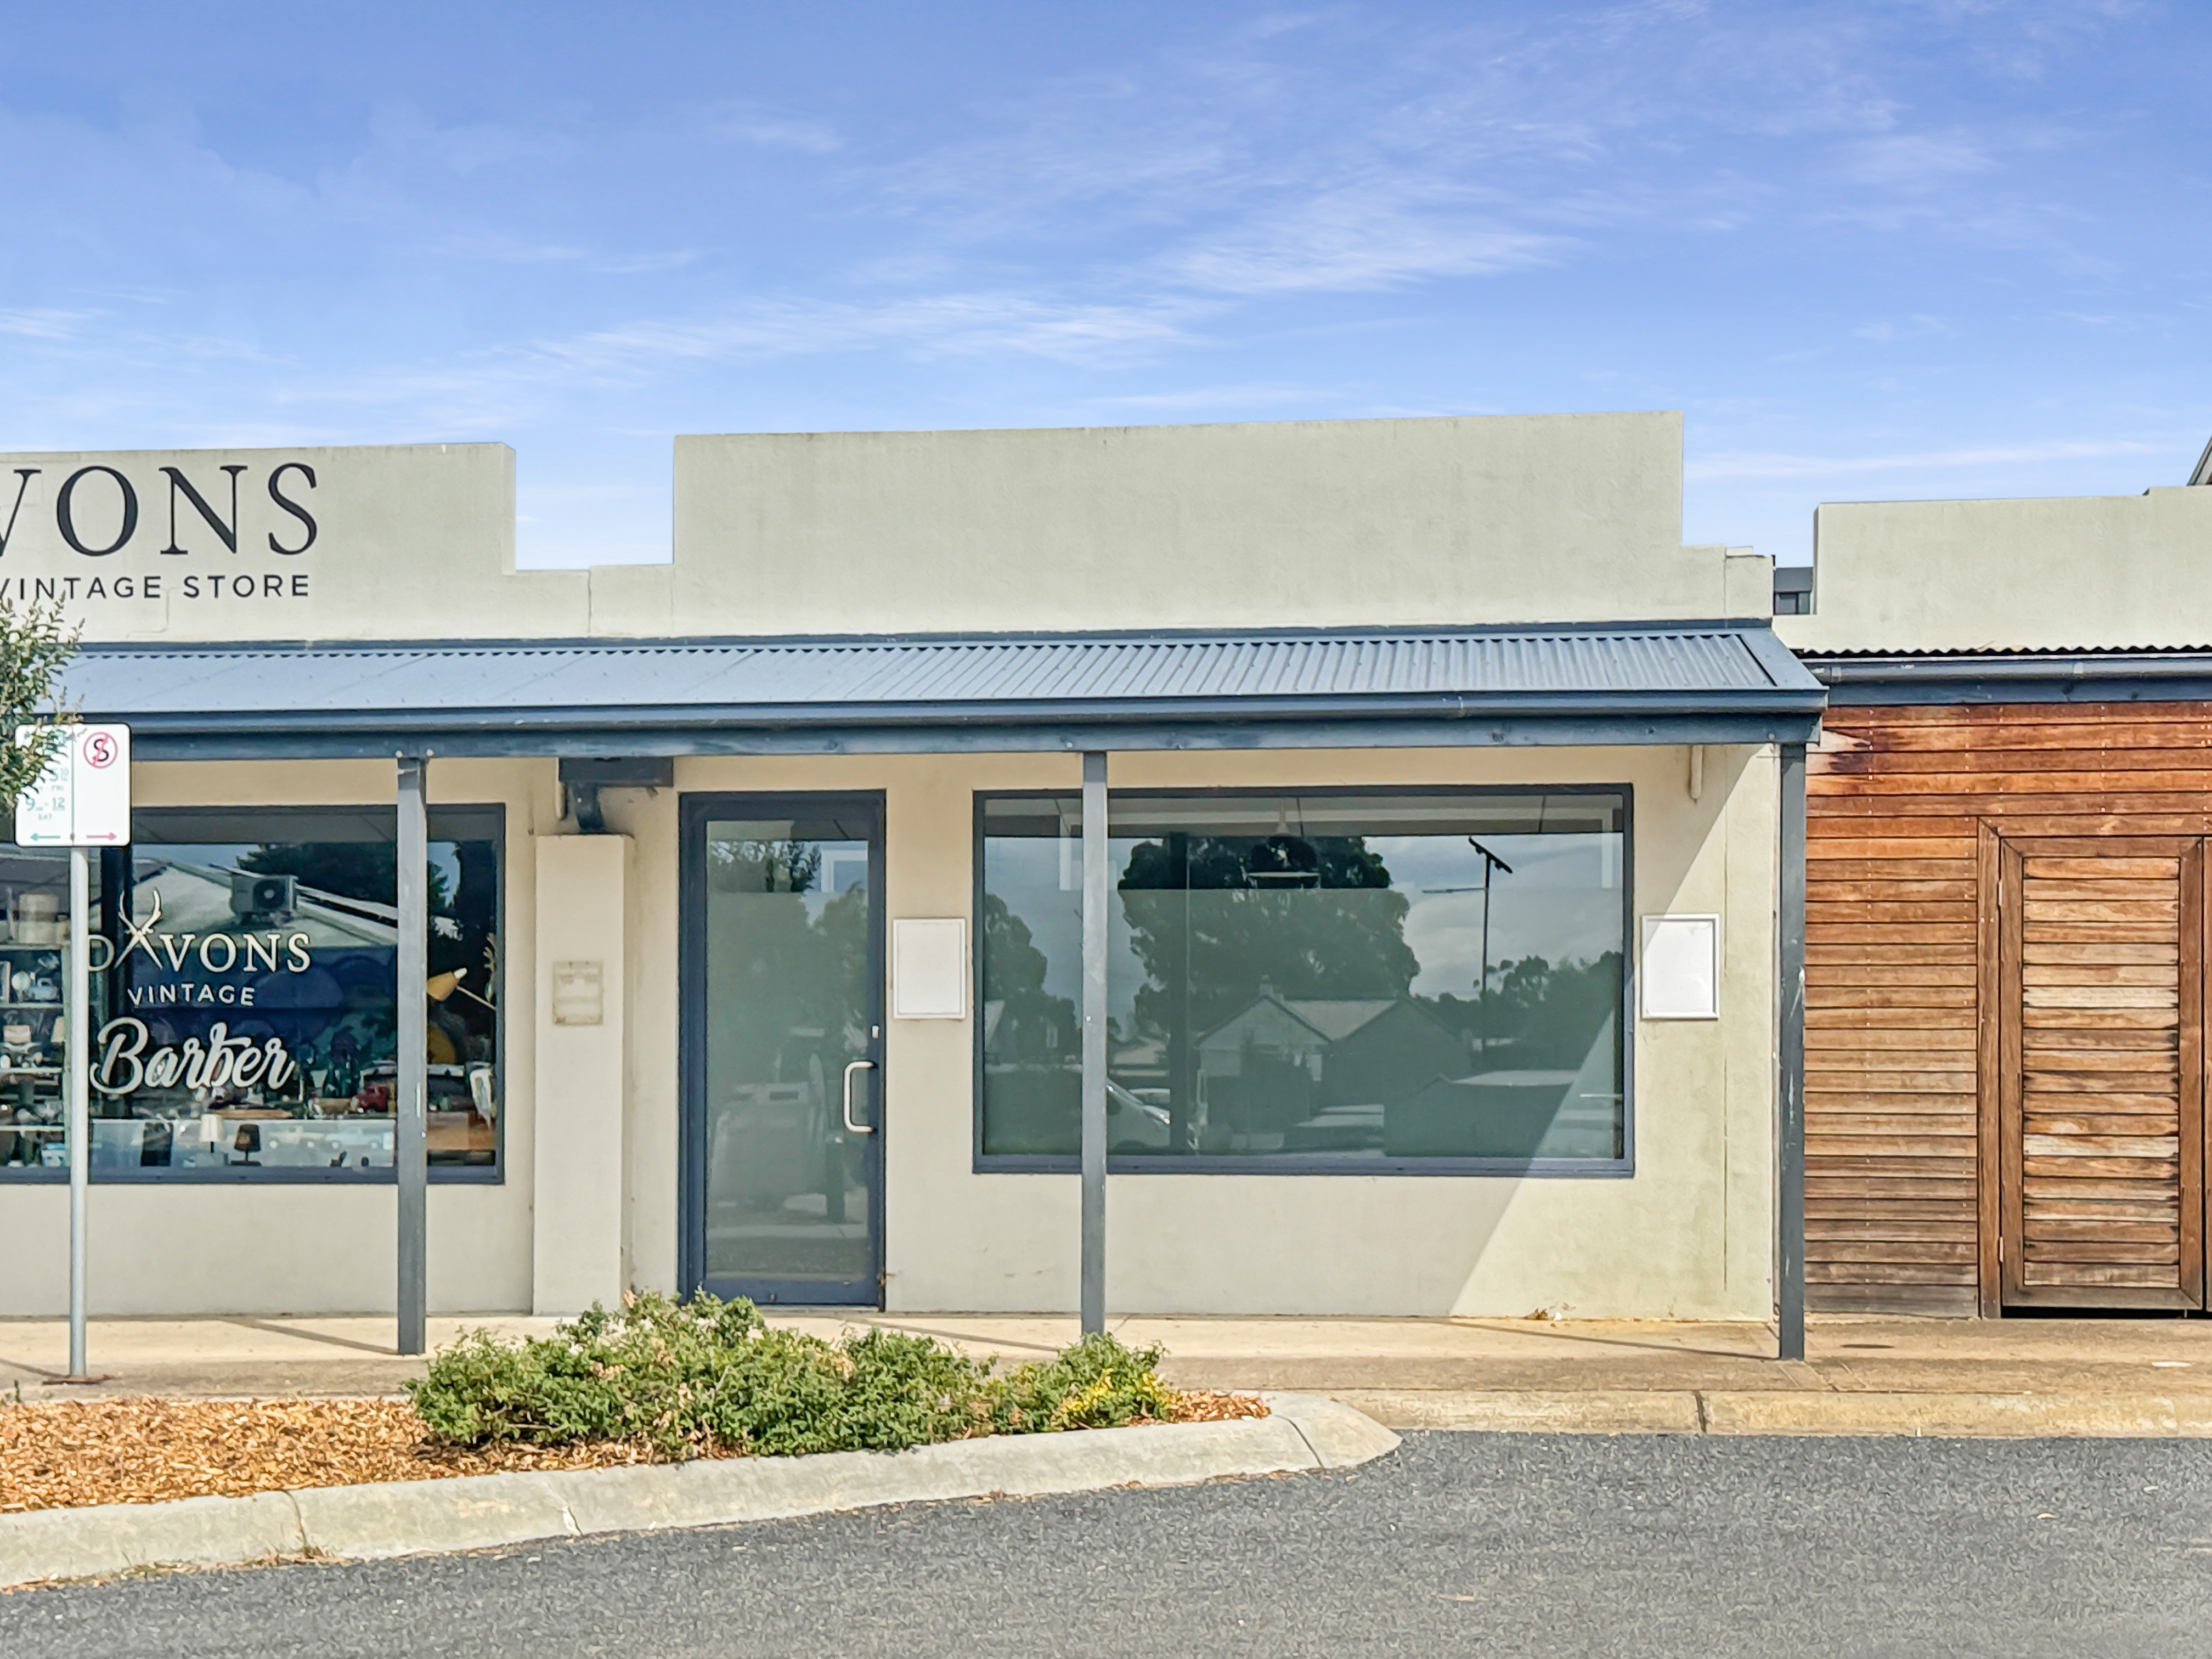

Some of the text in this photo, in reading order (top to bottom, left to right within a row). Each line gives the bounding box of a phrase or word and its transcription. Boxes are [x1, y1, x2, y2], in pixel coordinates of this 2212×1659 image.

[183, 574, 309, 599] STORE
[128, 983, 255, 1006] VINTAGE
[90, 1017, 295, 1095] Barber
